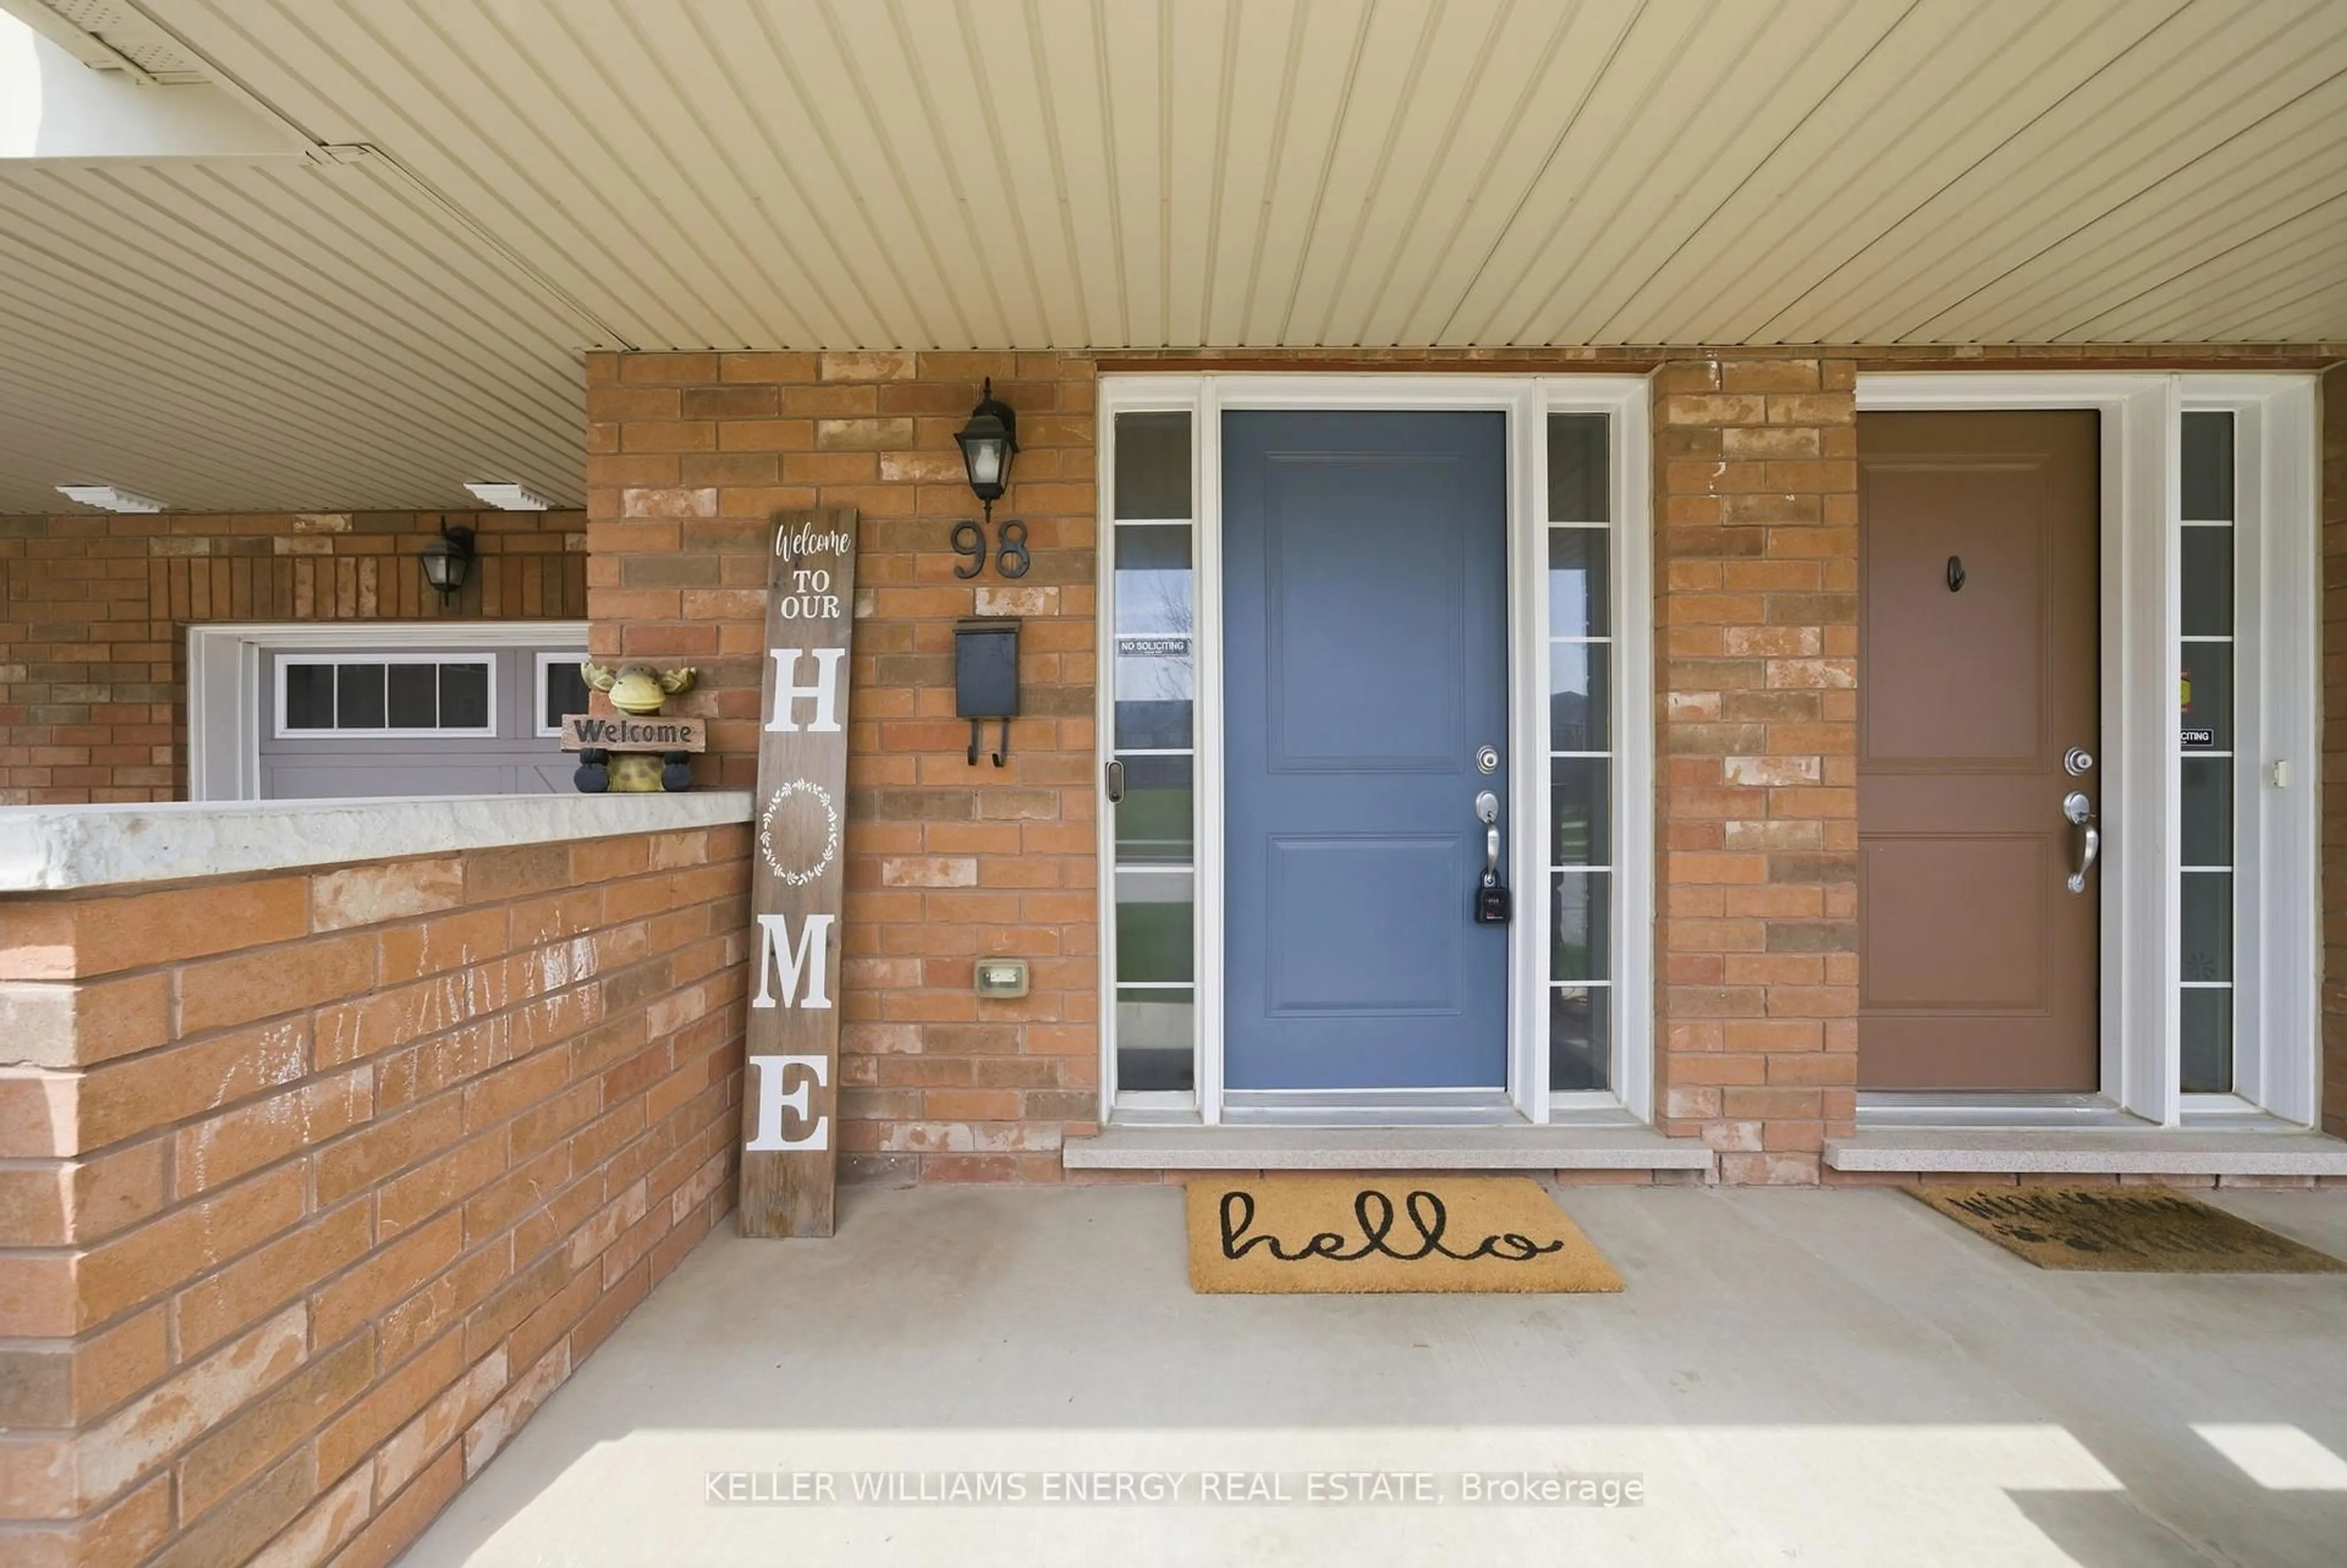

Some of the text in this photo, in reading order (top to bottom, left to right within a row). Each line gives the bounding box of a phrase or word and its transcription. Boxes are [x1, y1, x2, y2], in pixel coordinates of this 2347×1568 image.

[776, 522, 851, 563] Welcome
[950, 519, 1030, 579] 98
[793, 570, 830, 593] TO
[780, 595, 840, 620] OUR
[1122, 641, 1185, 650] NO SOLICITING
[573, 719, 692, 742] Welcome
[2181, 732, 2209, 741] CITING
[1221, 1190, 1563, 1260] hello
